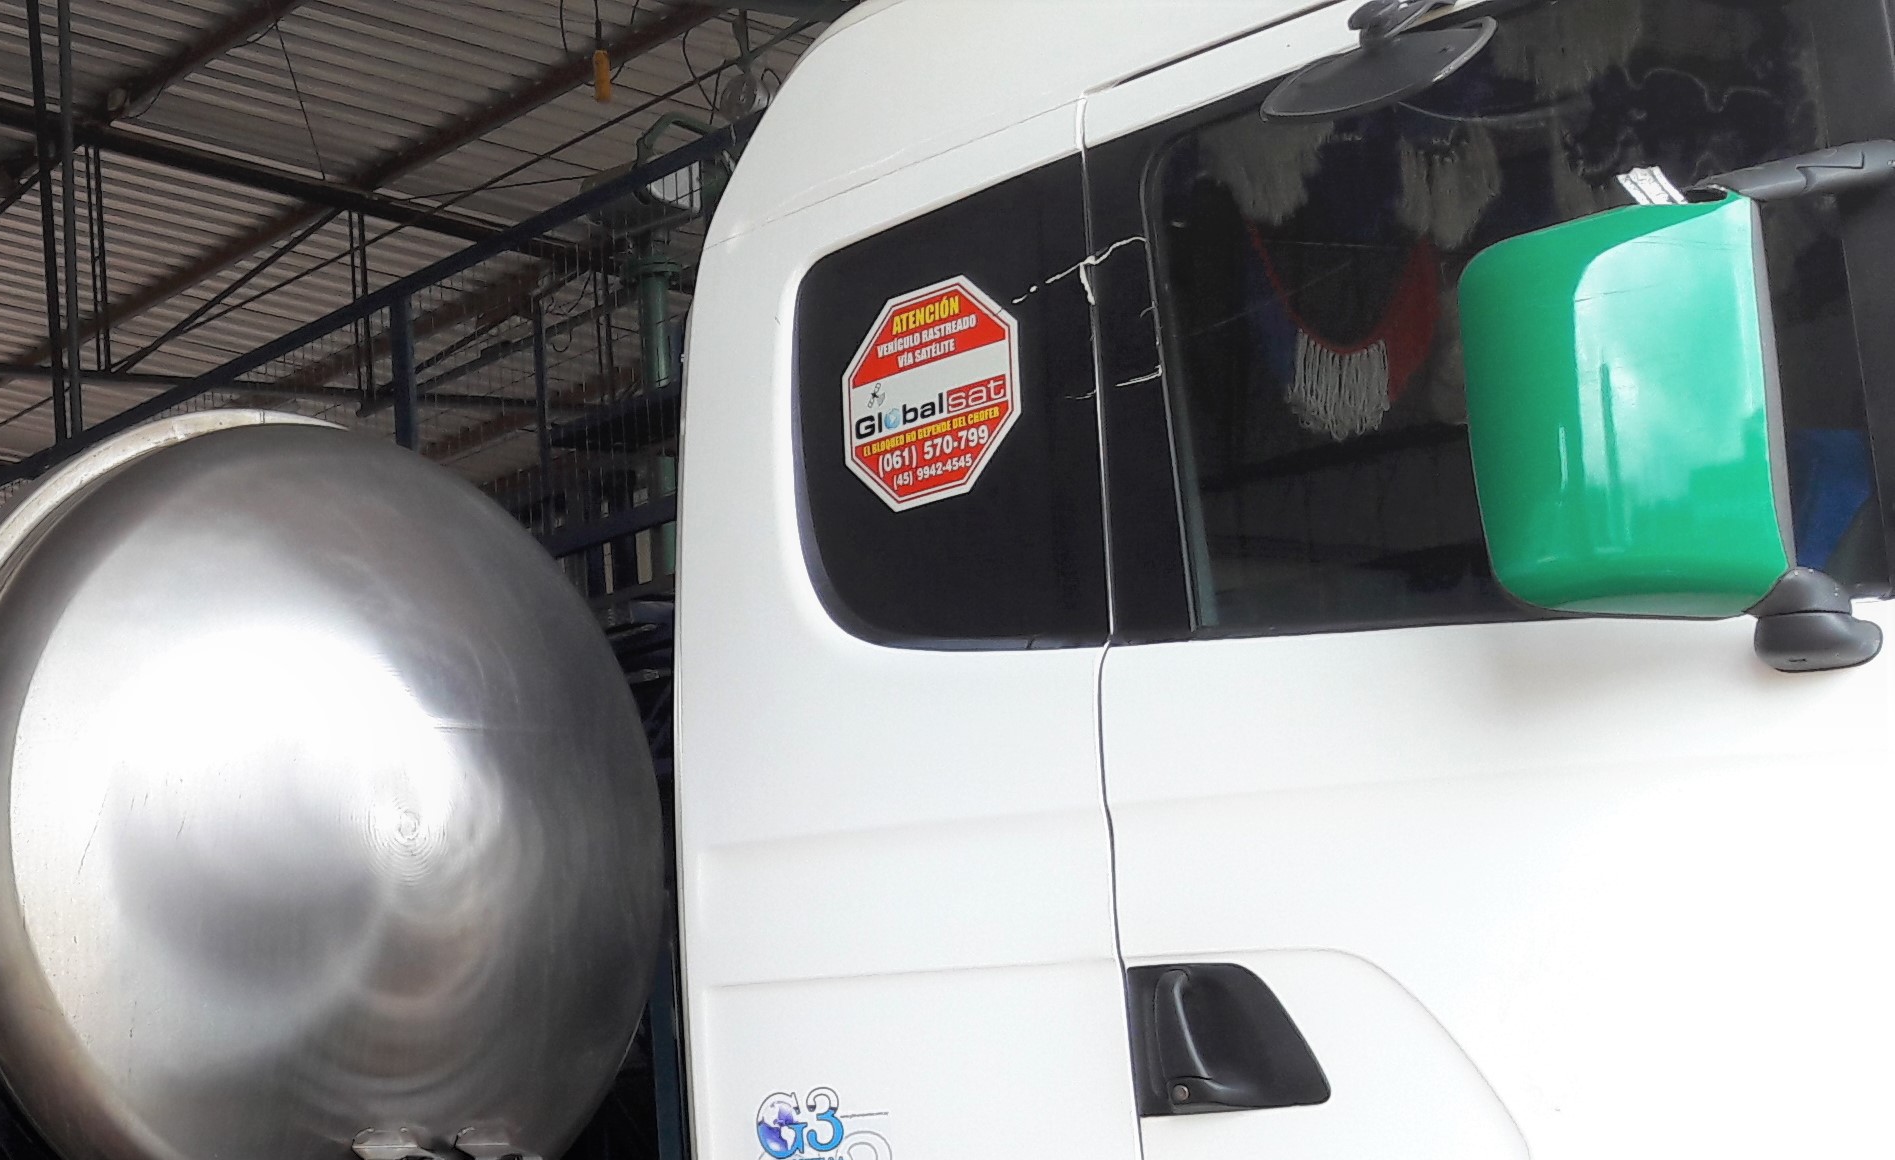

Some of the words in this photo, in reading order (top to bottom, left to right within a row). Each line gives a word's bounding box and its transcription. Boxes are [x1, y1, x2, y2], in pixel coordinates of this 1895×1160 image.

[876, 334, 921, 359] VEHÍCULO
[921, 314, 978, 343] RASTREADO
[892, 295, 960, 335] ATENCIÓN
[897, 350, 914, 369] VÍA
[914, 338, 956, 363] SATÉLITE
[871, 432, 905, 455] BLOQUEO
[905, 430, 917, 444] NO
[917, 419, 952, 441] DEPENDE
[952, 415, 967, 430] DEL
[967, 406, 1001, 426] CHOFER
[878, 445, 918, 479] (061)
[923, 425, 990, 460] 570-799
[893, 470, 914, 491] (45)
[916, 453, 973, 481] 9942-4545
[756, 1086, 844, 1160] G3
